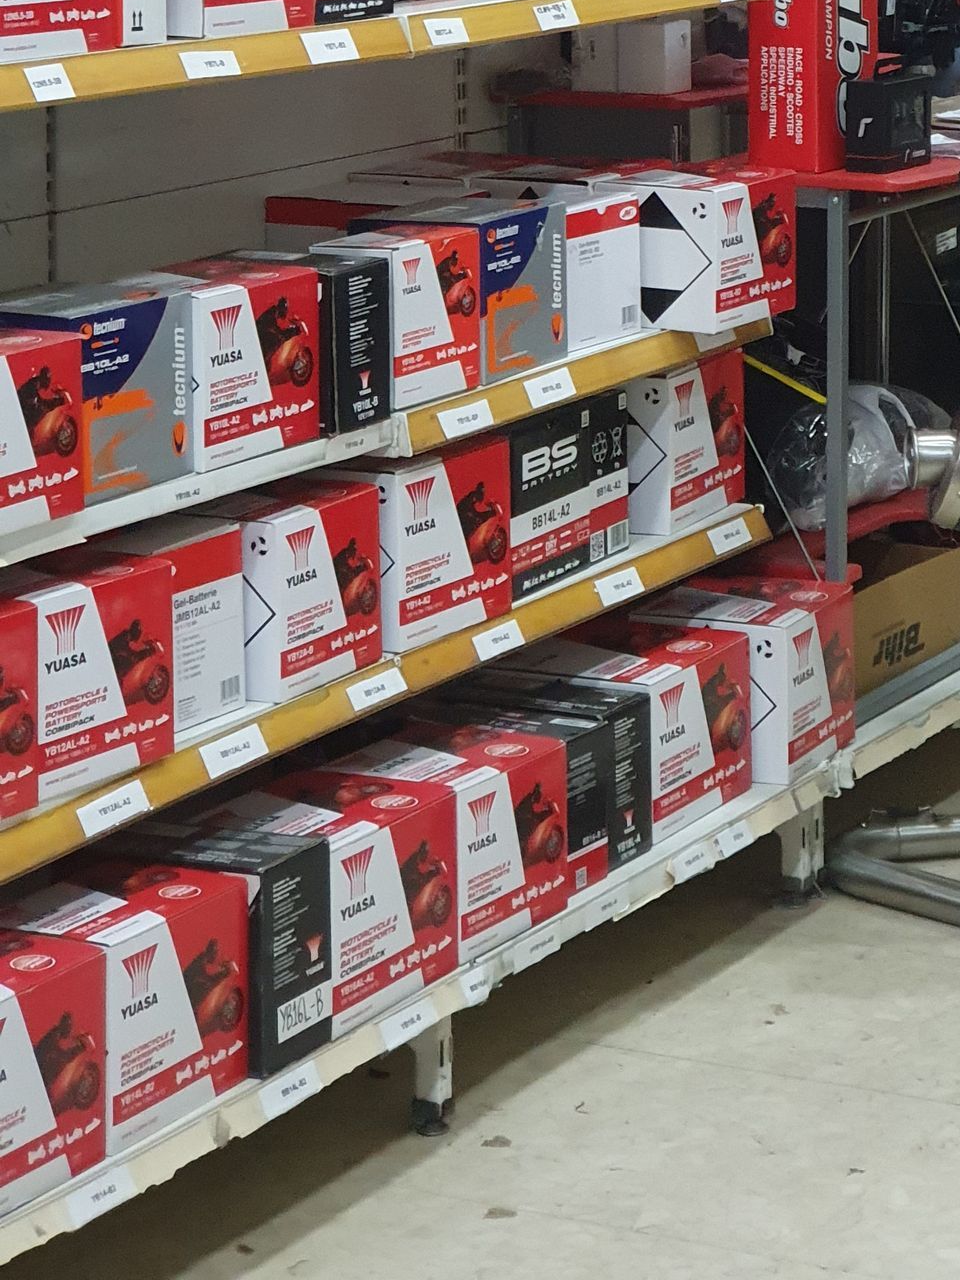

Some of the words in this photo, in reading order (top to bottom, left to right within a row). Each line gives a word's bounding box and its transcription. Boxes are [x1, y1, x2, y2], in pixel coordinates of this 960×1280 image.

[769, 47, 777, 84] SPECIAL
[777, 47, 786, 97] SPEEDWAY
[786, 47, 794, 84] ENDURO
[795, 47, 803, 72] RACE
[760, 47, 768, 112] APPLICATIONS
[795, 80, 803, 106] ROAD
[769, 86, 777, 139] INDUSTRIAL
[786, 93, 794, 136] SCOOTER
[795, 113, 803, 145] CROSS
[721, 235, 744, 249] YUASA
[551, 233, 562, 309] tecnium
[172, 325, 186, 416] tecnium
[210, 349, 243, 368] YUASA
[522, 435, 577, 482] BS
[522, 464, 578, 492] BATTERY
[405, 518, 436, 537] YUASA
[532, 504, 571, 530] BB14L-A2
[286, 569, 317, 589] YUASA
[174, 588, 217, 610] Gel-Batterie
[45, 653, 87, 675] YUASA
[793, 666, 815, 687] YUASA
[45, 689, 100, 711] MOTORCYCLE
[45, 695, 107, 720] POWERSPORTS
[45, 712, 82, 728] BATTERY
[45, 715, 96, 737] COMBIPACK
[44, 735, 90, 758] YB12AL-A2
[659, 724, 686, 746] YUASA
[468, 833, 497, 854] YUASA
[340, 895, 376, 921] YUASA
[340, 918, 391, 949] MOTORCYCLE
[340, 926, 397, 960] POWERSPORTS
[340, 946, 375, 968] BATTERY
[340, 948, 386, 978] COMBIPACK
[121, 993, 158, 1020] YUASA
[280, 988, 324, 1033] YB16L-B
